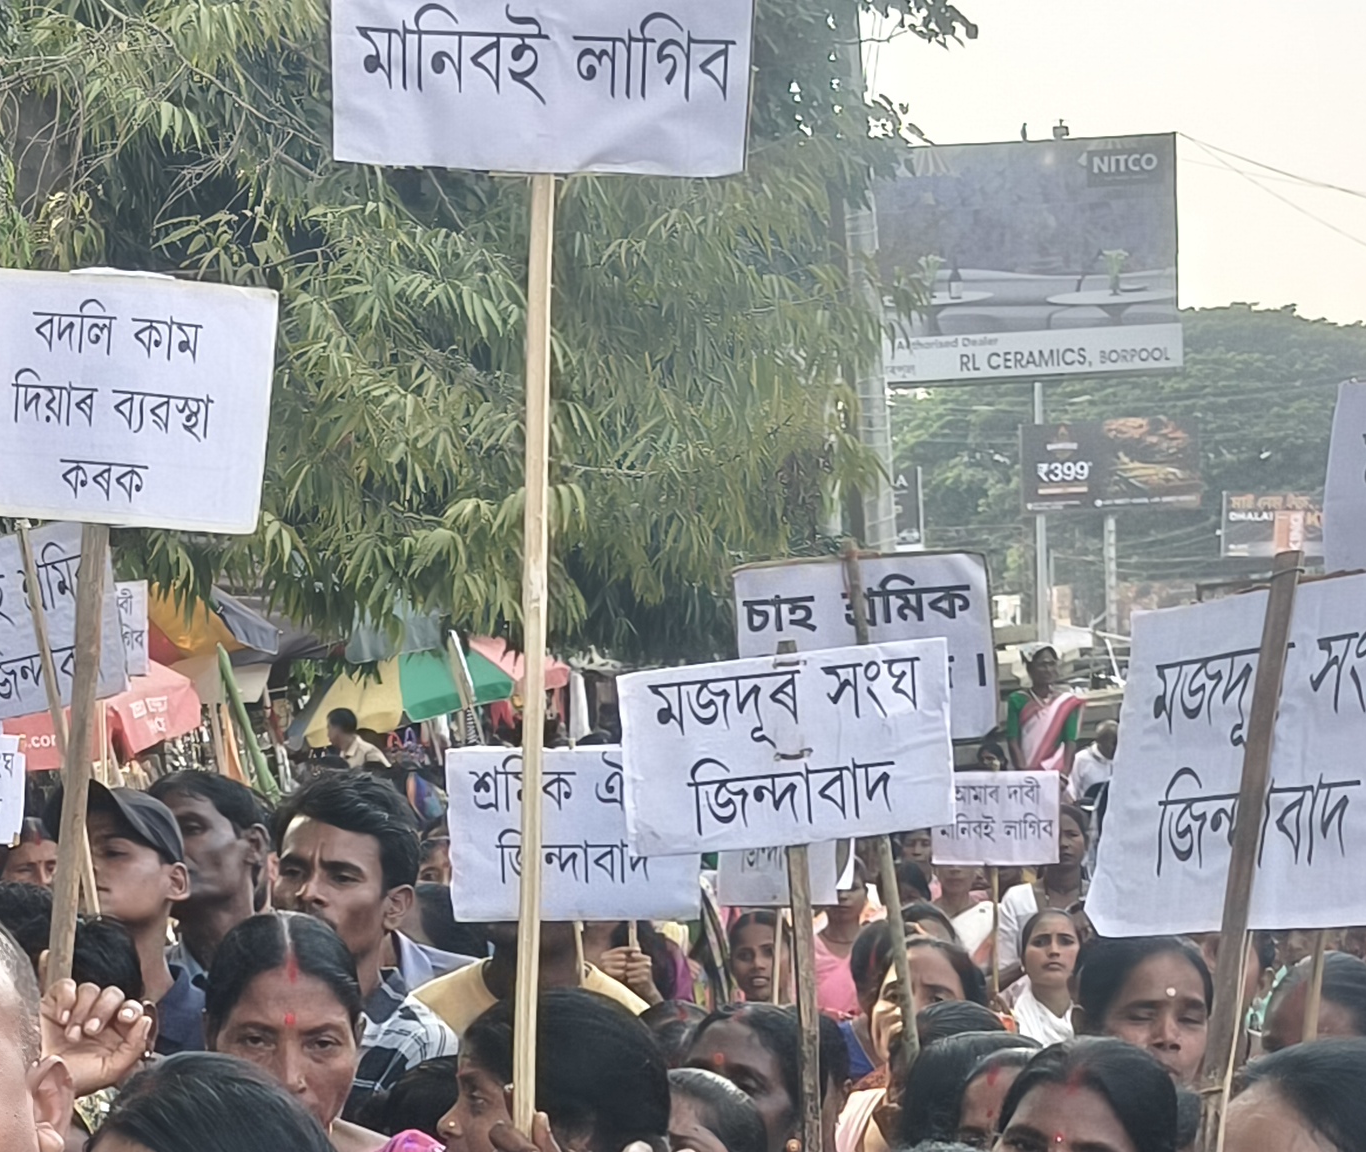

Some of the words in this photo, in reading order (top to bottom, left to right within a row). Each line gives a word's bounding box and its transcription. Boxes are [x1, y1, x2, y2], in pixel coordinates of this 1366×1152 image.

[356, 3, 550, 105] মানিবই
[573, 12, 737, 101] লাগিব
[1092, 153, 1158, 174] NITCO
[33, 298, 117, 356] বদলি
[131, 315, 203, 364] কাম
[960, 353, 981, 372] RL
[987, 347, 1093, 370] CERAMICS,
[1099, 347, 1171, 365] BORPOOL
[11, 367, 99, 427] দিয়াৰ
[60, 458, 149, 503] কৰক
[742, 594, 818, 632] চাহ
[647, 669, 801, 749] মজদূৰ
[821, 656, 921, 719] সংঘ
[687, 758, 896, 837] জিন্দাবাদ
